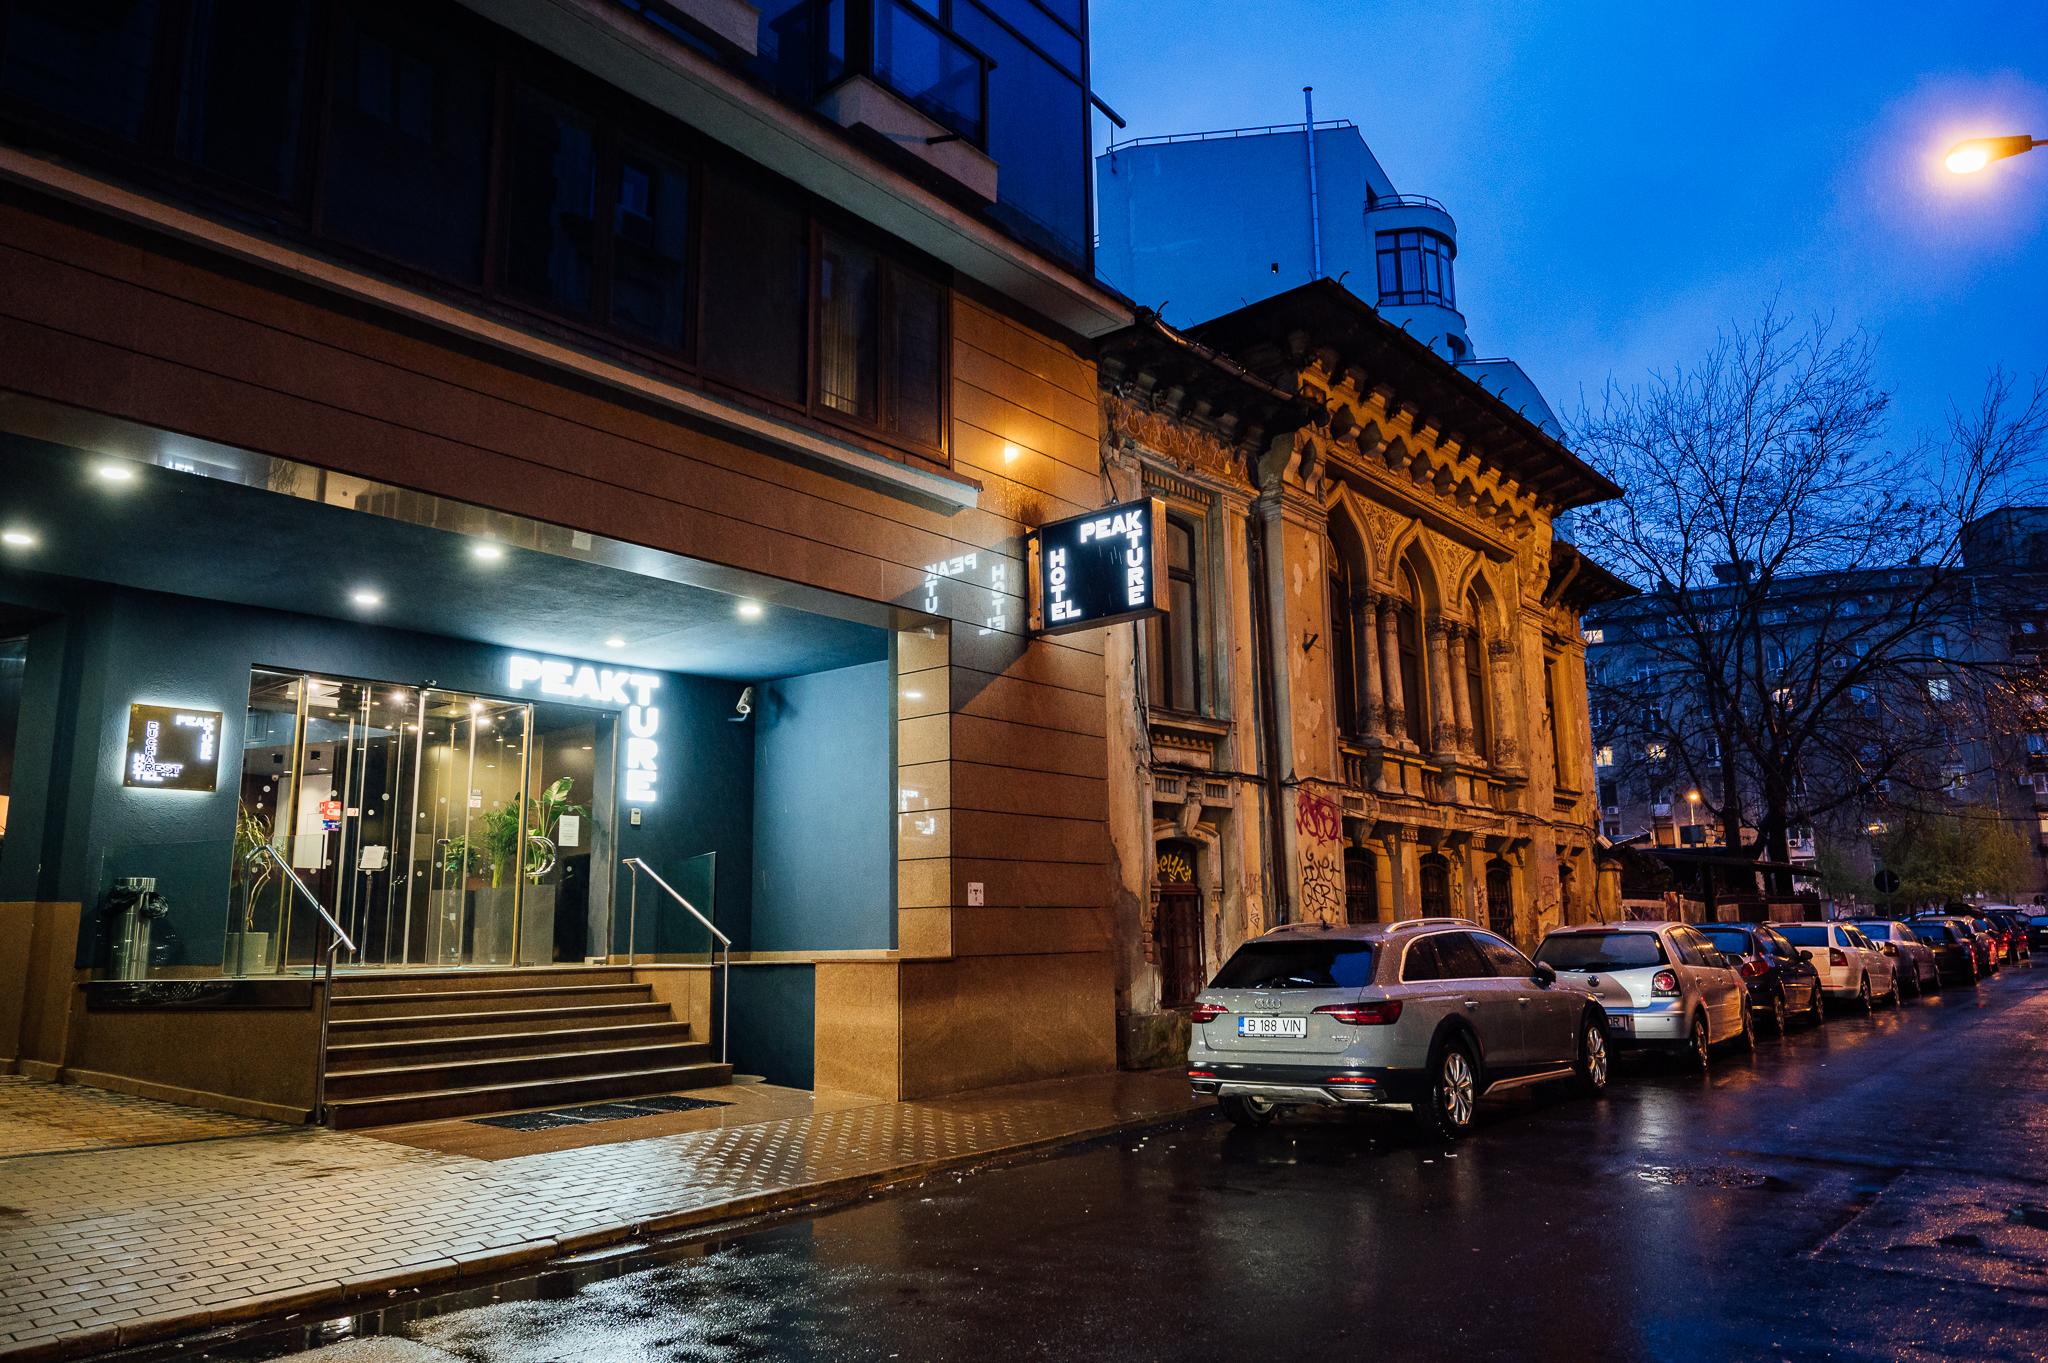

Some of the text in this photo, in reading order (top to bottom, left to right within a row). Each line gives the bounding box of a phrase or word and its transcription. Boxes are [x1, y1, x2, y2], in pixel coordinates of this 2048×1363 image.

[1050, 548, 1081, 622] HOTEL
[1248, 1019, 1301, 1032] B 188 VIN
